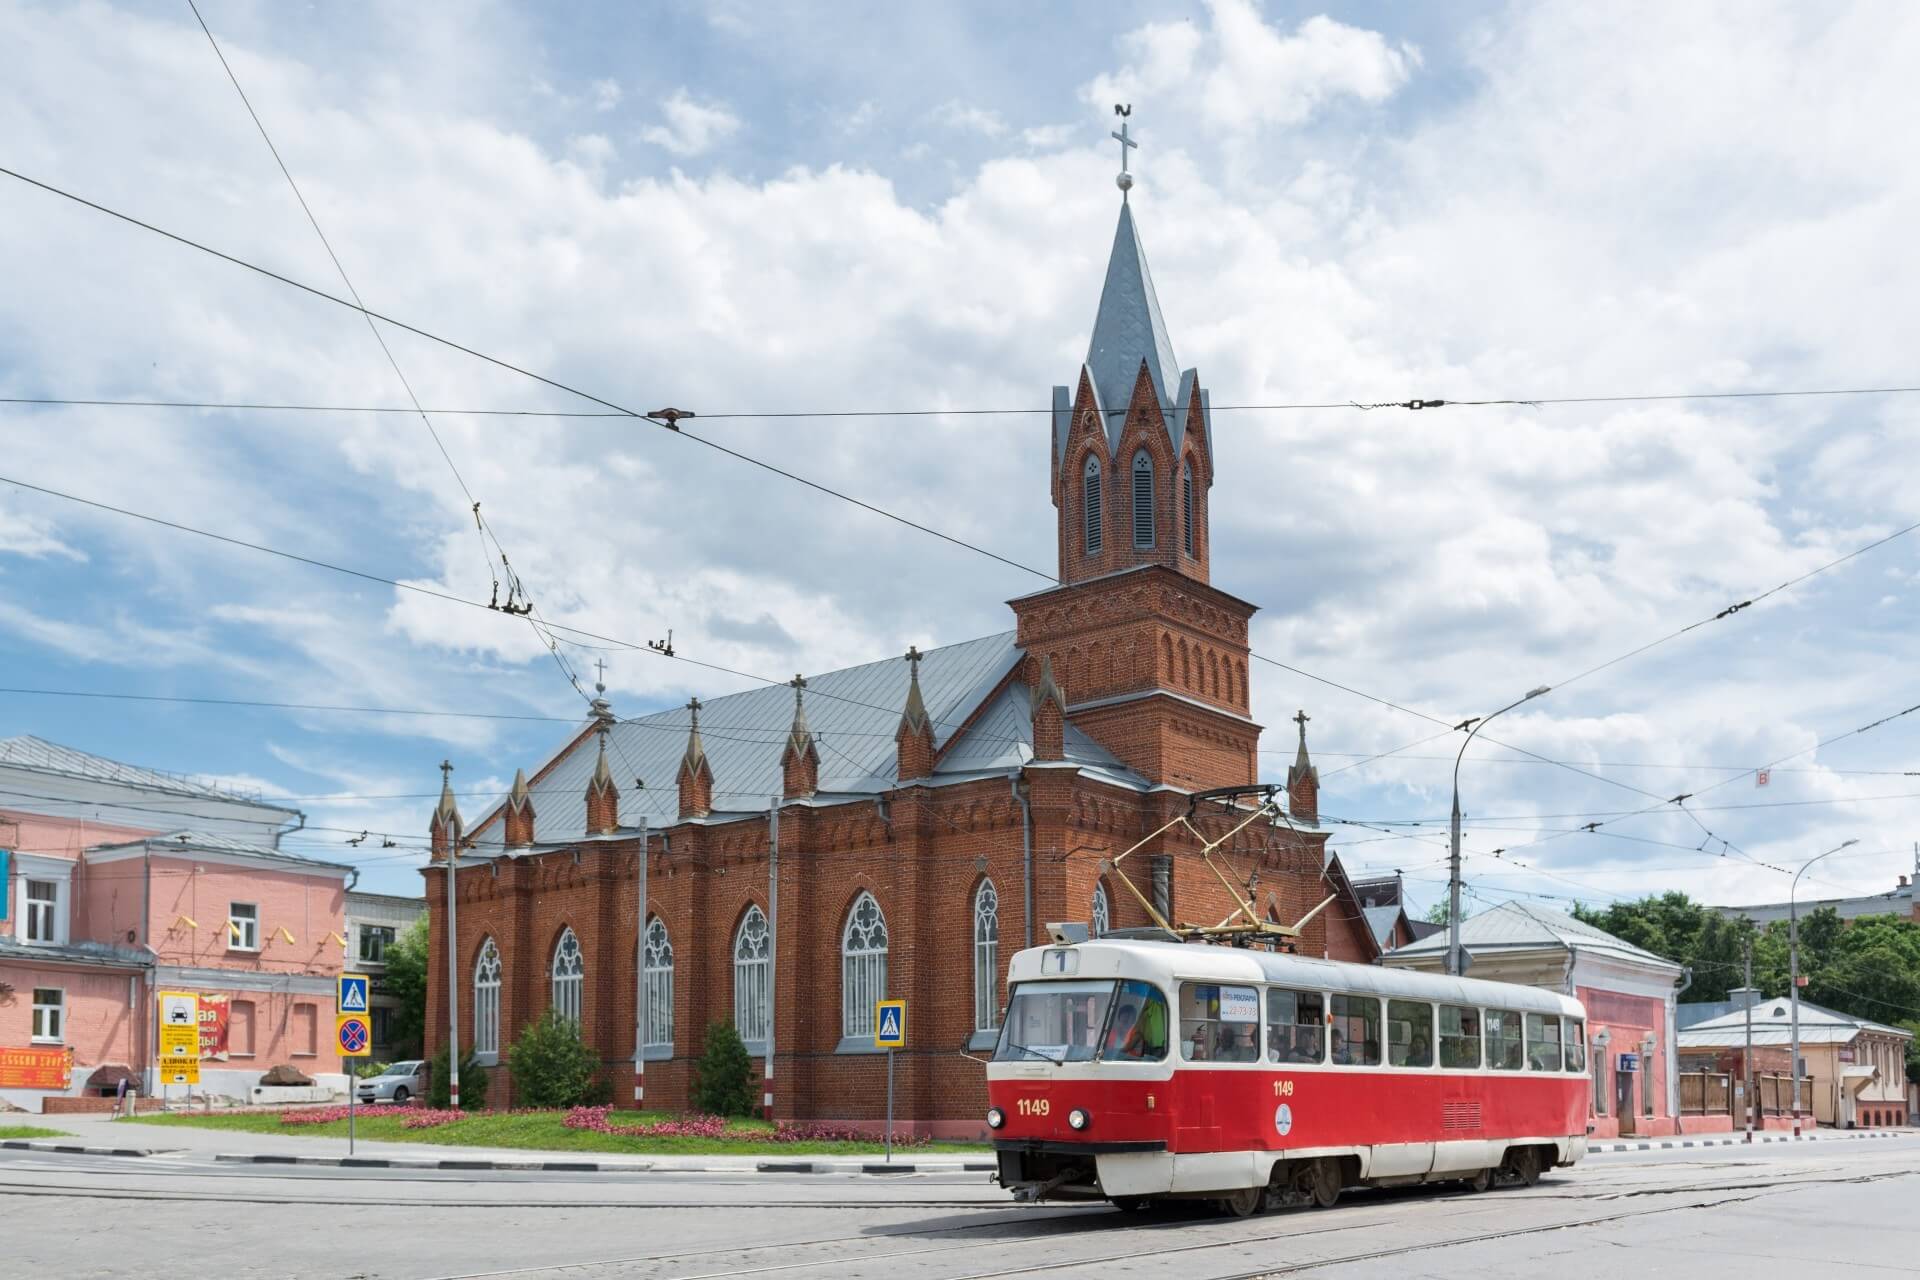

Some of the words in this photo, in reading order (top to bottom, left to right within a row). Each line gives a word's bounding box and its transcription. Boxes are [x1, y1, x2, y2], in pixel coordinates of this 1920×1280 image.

[1056, 951, 1066, 972] 1
[1273, 1080, 1294, 1096] 1149
[1017, 1098, 1050, 1116] 1149
